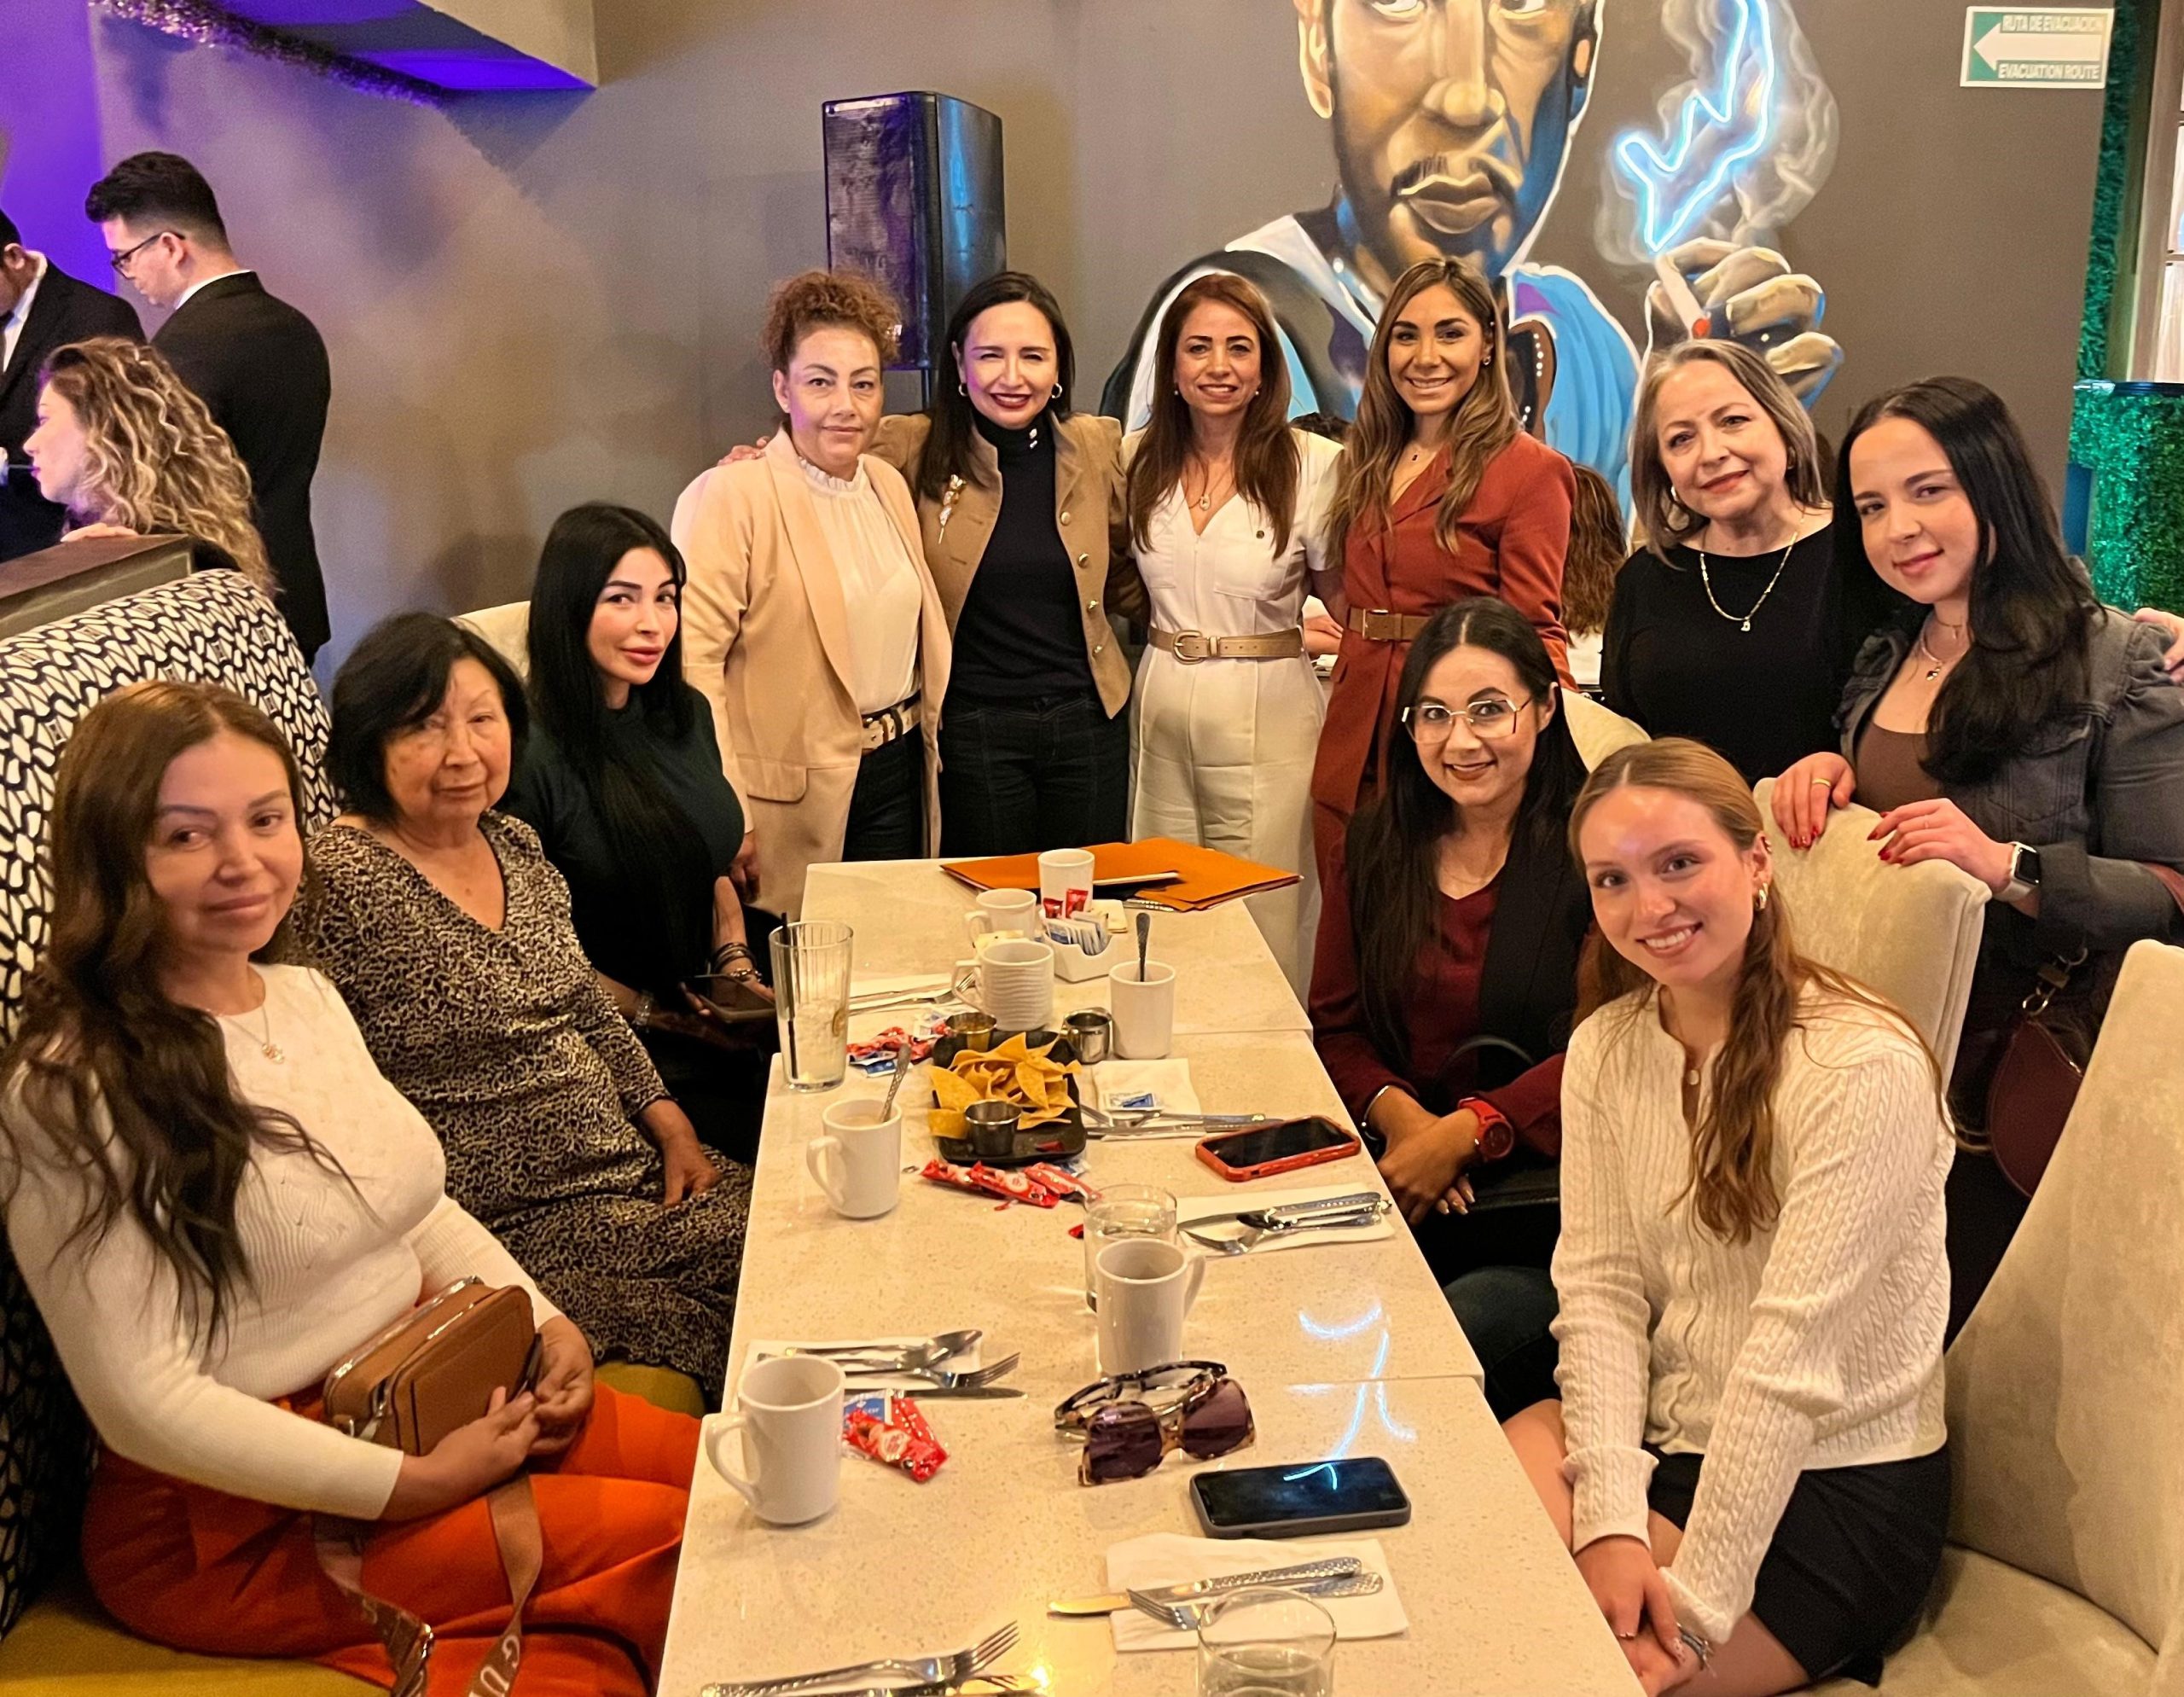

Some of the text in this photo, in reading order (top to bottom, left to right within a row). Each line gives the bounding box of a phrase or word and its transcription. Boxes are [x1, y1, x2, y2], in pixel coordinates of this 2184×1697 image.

[2002, 15, 2028, 32] RUTA
[2029, 15, 2043, 32] DE
[1998, 63, 2100, 79] EVACUATION ROUTE
[468, 1635, 520, 1697] GU
